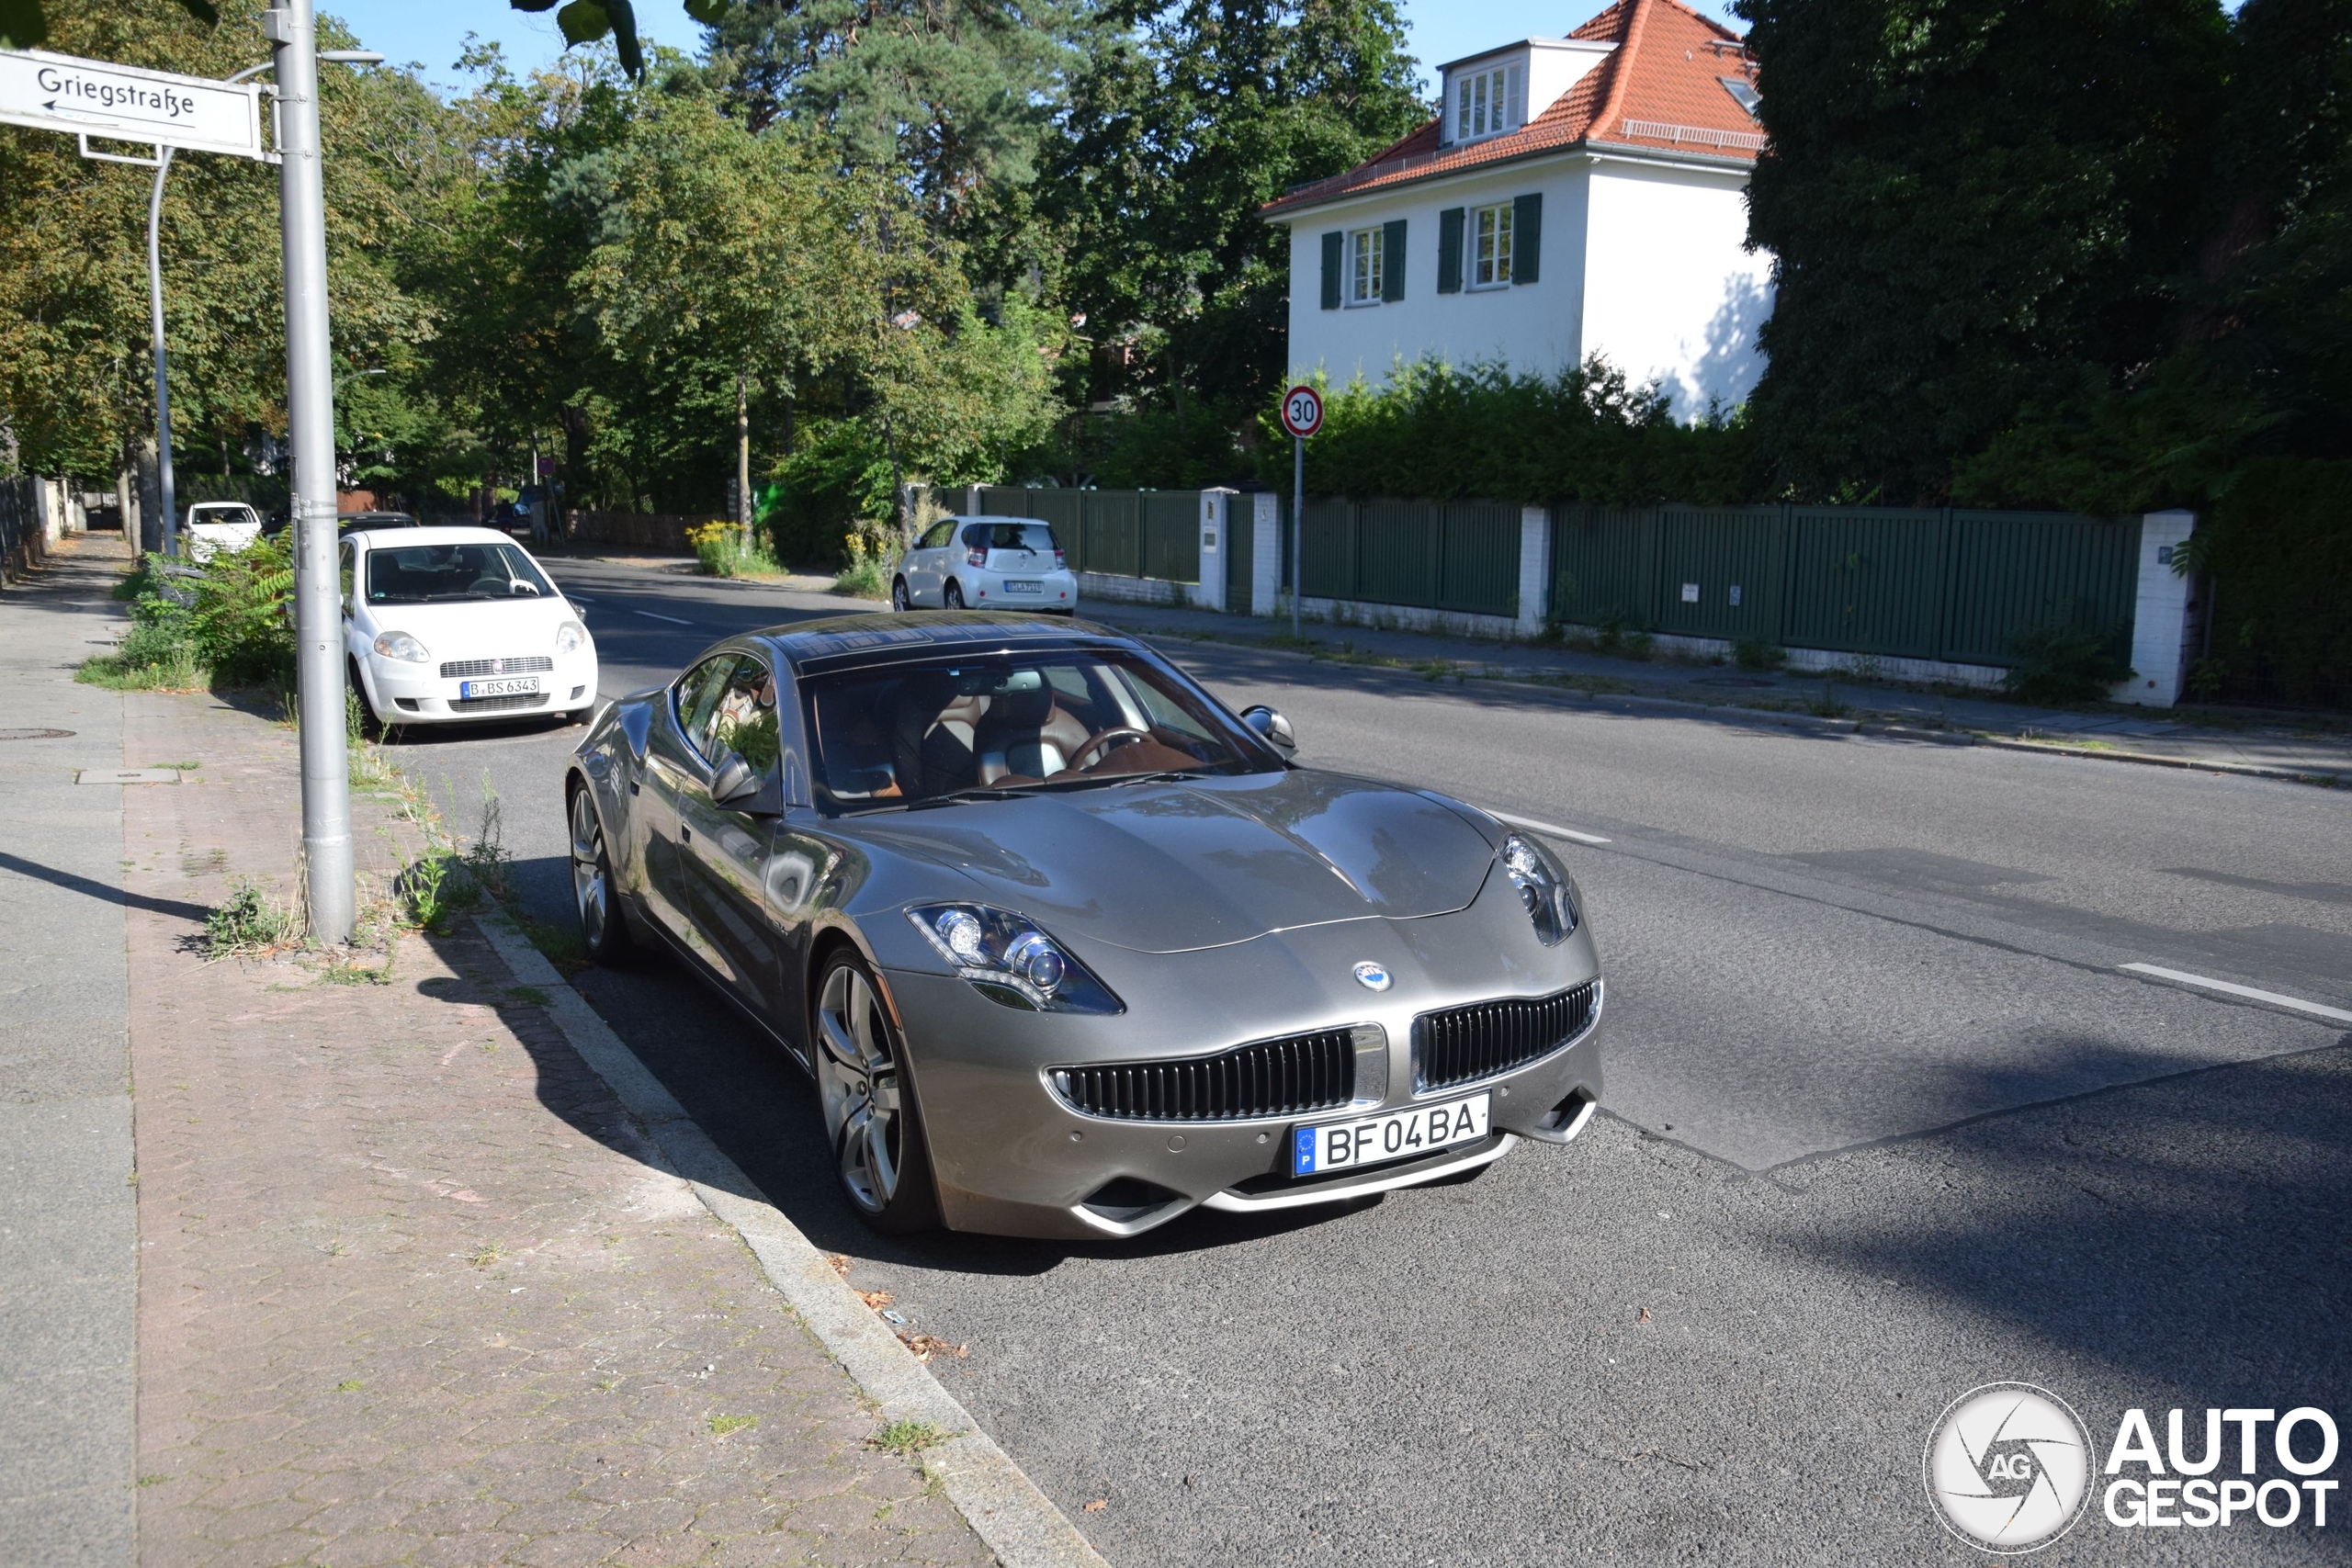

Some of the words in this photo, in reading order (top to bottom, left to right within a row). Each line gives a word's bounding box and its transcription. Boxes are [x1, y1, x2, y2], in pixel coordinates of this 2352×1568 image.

[38, 68, 195, 118] Griegstraße
[1291, 400, 1315, 423] 30
[470, 683, 479, 695] B
[487, 682, 503, 694] BS
[506, 679, 537, 693] 6343
[1328, 1122, 1377, 1165] BF
[1384, 1114, 1422, 1154] 04
[1429, 1102, 1475, 1145] BA
[1302, 1155, 1311, 1166] P
